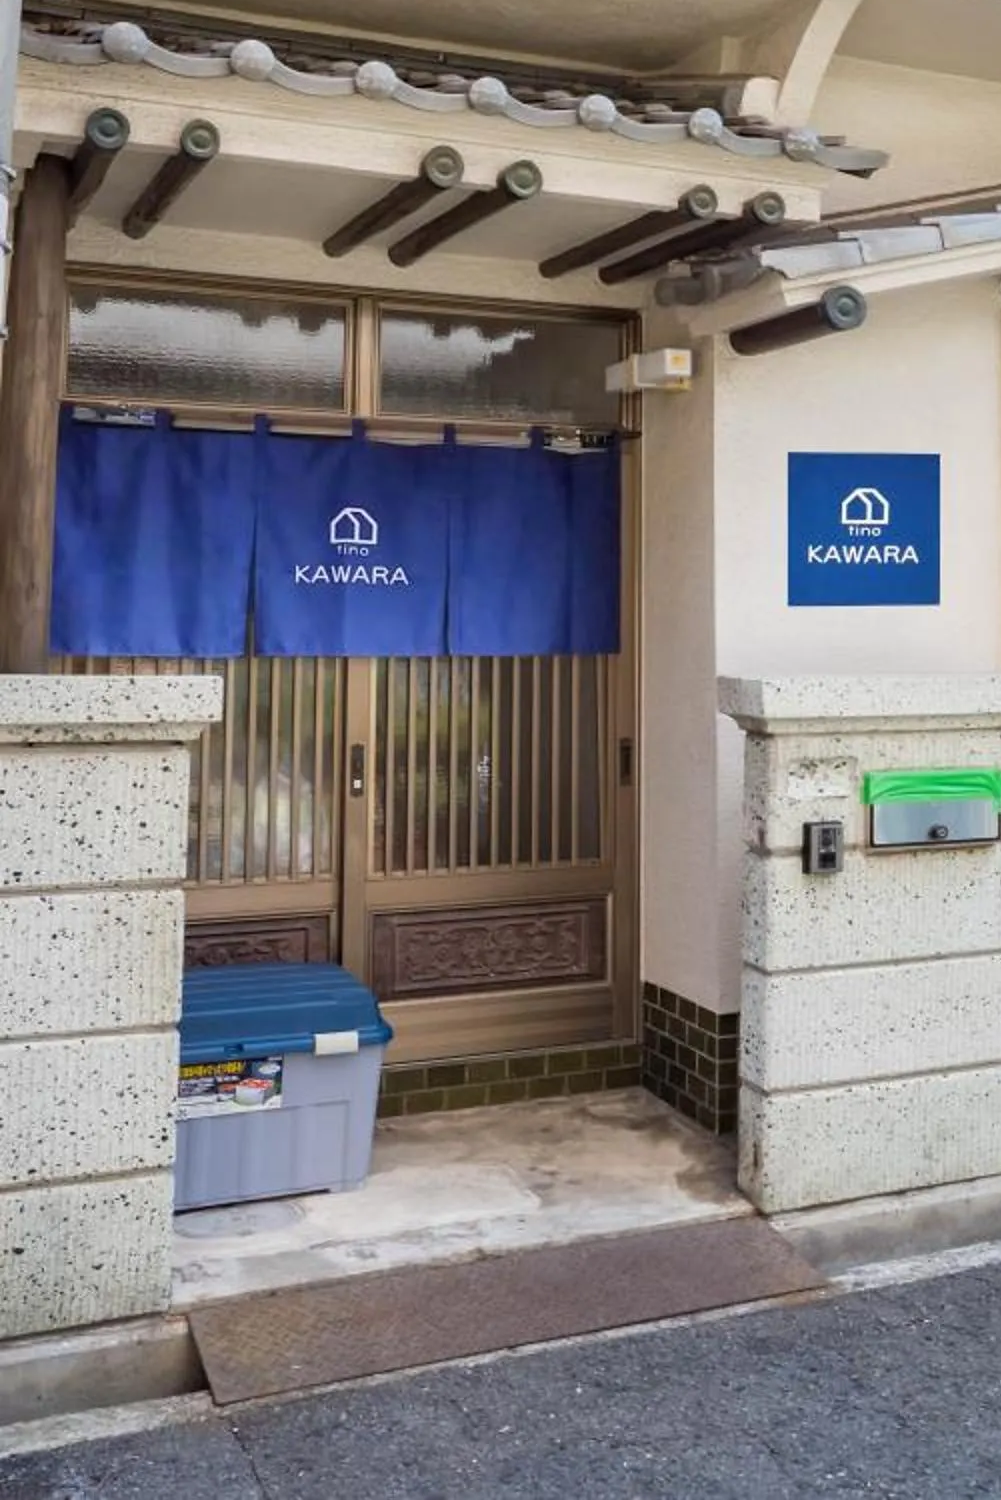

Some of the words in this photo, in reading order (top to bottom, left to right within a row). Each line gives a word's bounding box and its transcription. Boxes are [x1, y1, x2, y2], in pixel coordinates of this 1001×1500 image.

[848, 524, 882, 537] tino
[337, 544, 369, 557] tino
[807, 544, 919, 564] KAWARA
[295, 565, 409, 585] KAWARA
